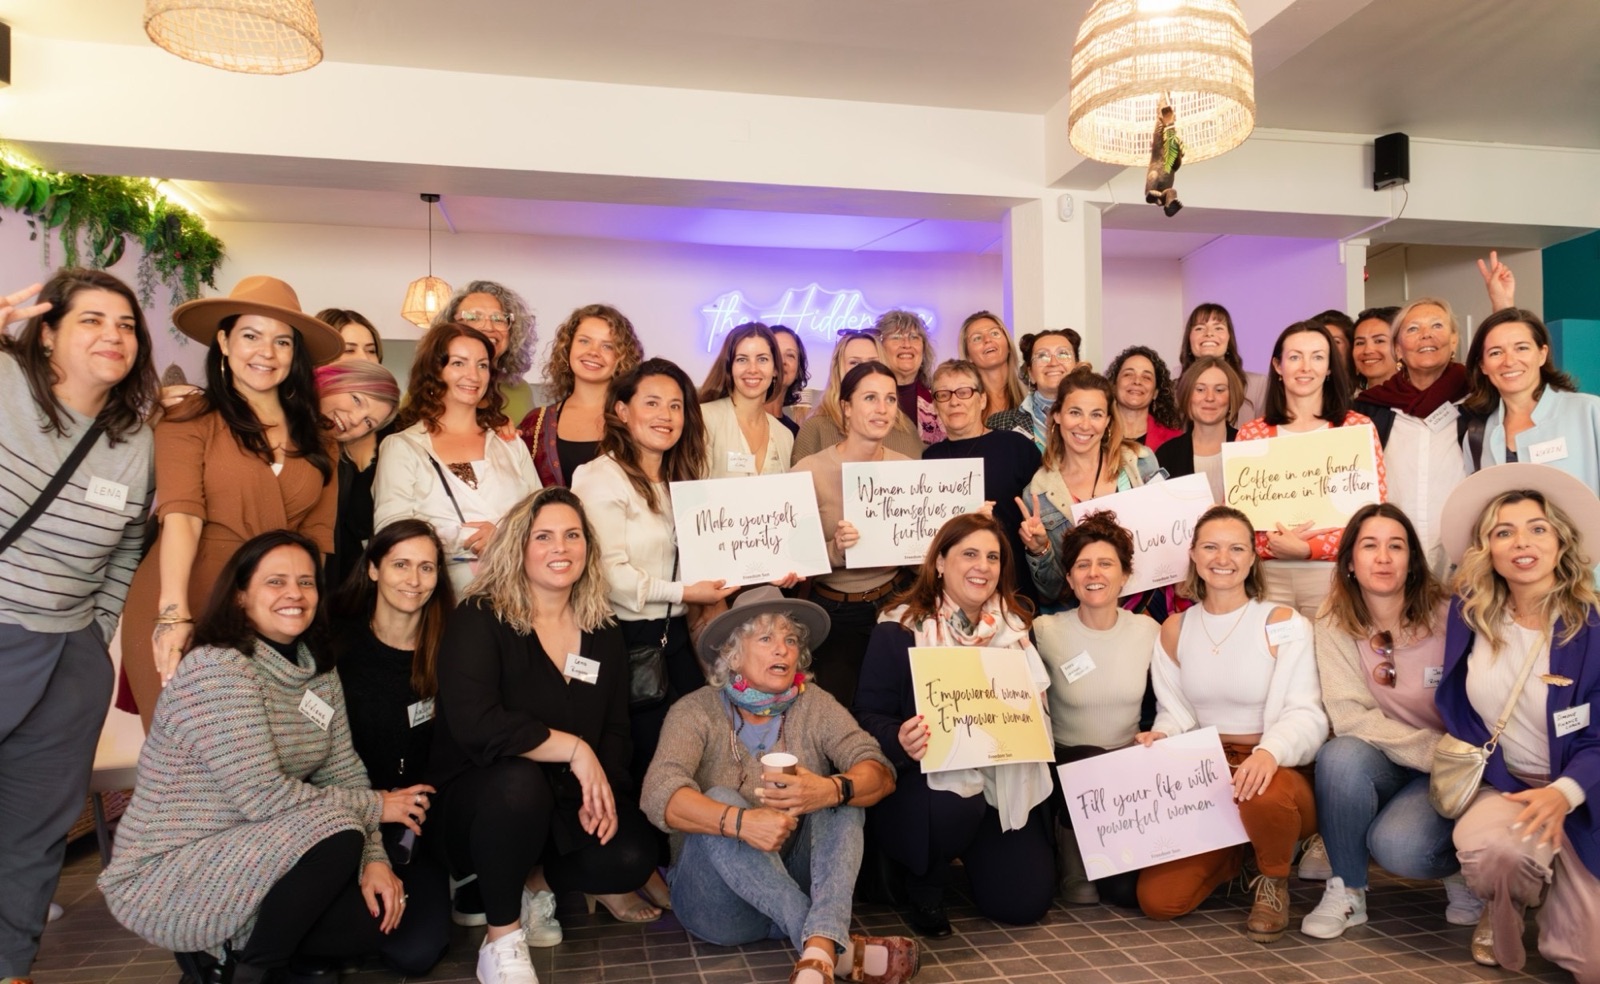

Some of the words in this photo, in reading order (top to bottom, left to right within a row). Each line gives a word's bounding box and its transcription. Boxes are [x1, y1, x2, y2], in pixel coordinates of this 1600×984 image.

[759, 285, 876, 341] Hidden
[857, 476, 905, 503] Women
[910, 473, 933, 495] who
[938, 471, 981, 496] invest
[1238, 466, 1280, 489] Coffee
[1285, 471, 1297, 481] in
[1302, 467, 1321, 478] one
[1326, 454, 1359, 473] hand
[93, 484, 122, 501] LENA
[1228, 484, 1297, 507] Confidence
[1302, 488, 1314, 498] in
[1314, 476, 1337, 498] the
[1342, 472, 1374, 495] other
[696, 507, 735, 536] Make
[739, 501, 798, 536] yourself
[865, 507, 877, 519] in
[877, 496, 947, 521] themselves
[951, 506, 966, 517] go
[718, 542, 726, 551] a
[731, 525, 782, 561] priority
[892, 516, 939, 547] further
[1135, 530, 1167, 553] Love
[1171, 514, 1202, 546] Clu
[925, 678, 999, 712] Empowered
[938, 704, 999, 738] Empower
[1077, 787, 1107, 820] Fill
[1113, 788, 1151, 817] your
[1155, 773, 1183, 800] life
[1188, 758, 1219, 788] with
[1097, 800, 1160, 847] powerful
[1167, 799, 1216, 820] women
